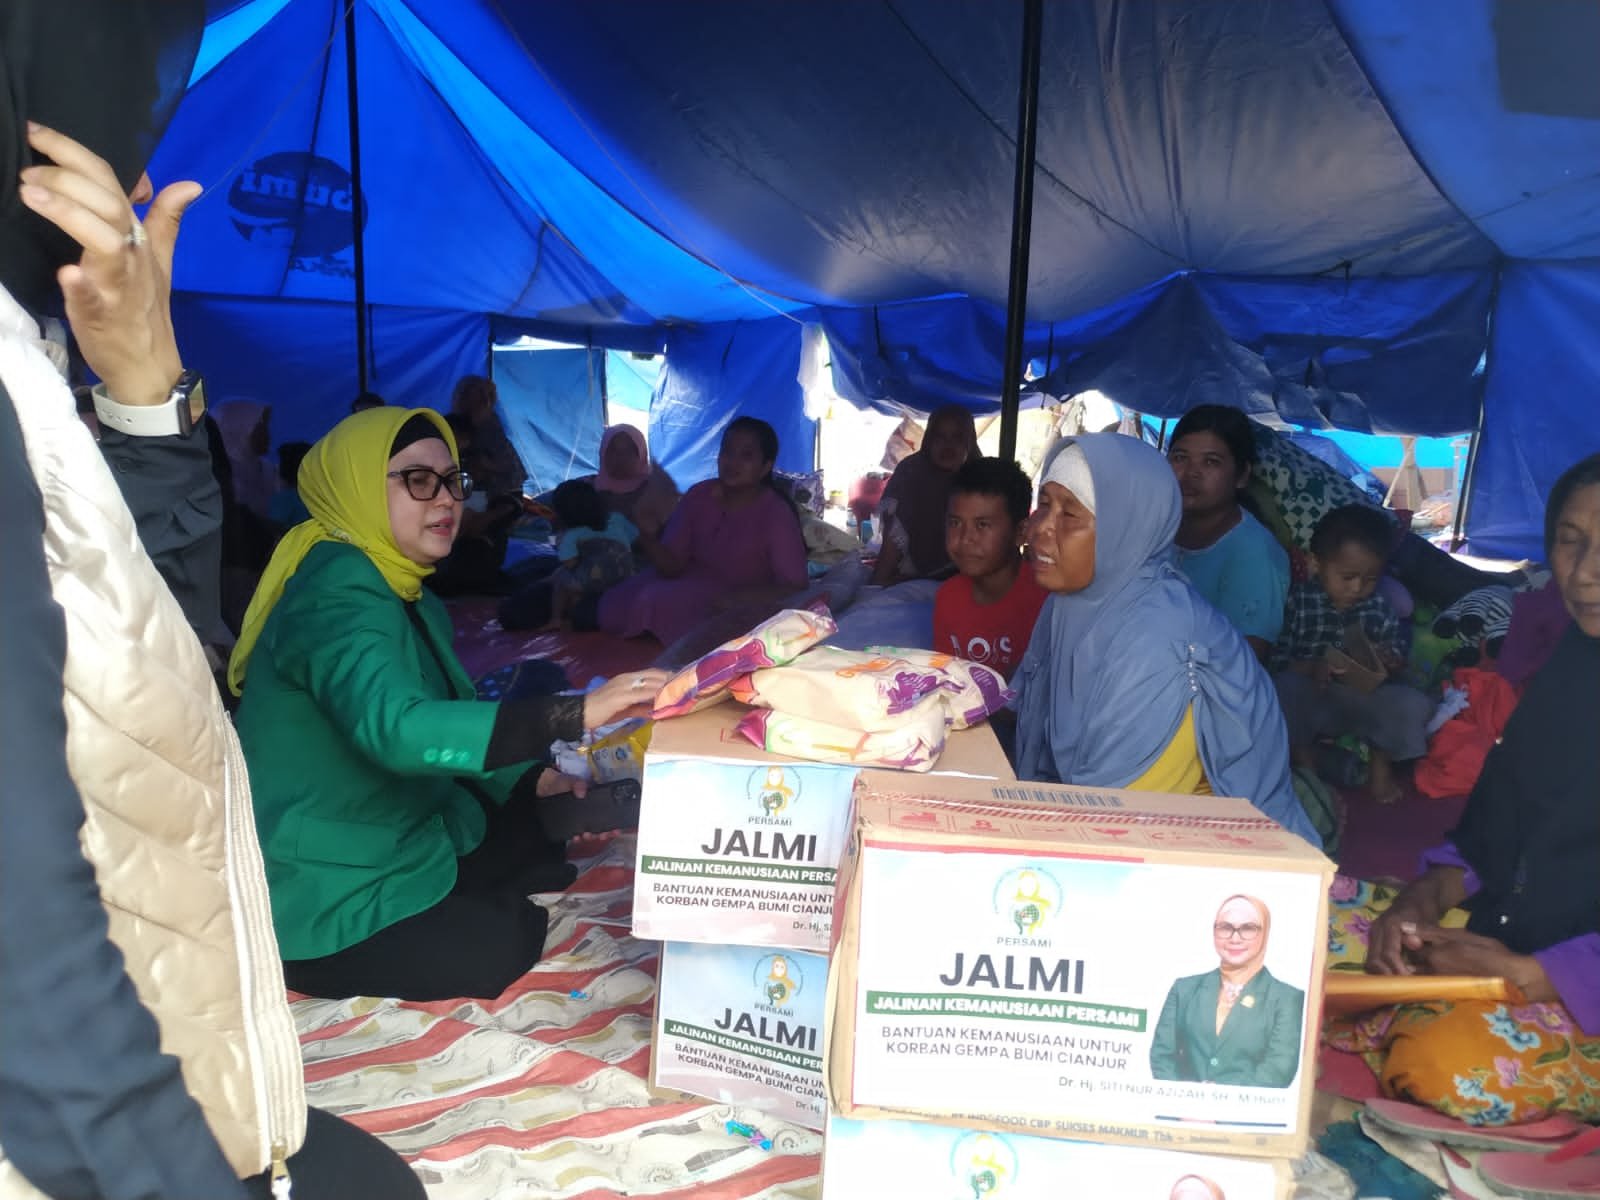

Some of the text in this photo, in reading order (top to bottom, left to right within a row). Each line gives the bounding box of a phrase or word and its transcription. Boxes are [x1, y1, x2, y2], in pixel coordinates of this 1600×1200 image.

[748, 816, 793, 827] PERSAMI
[701, 828, 817, 862] JALMI
[648, 860, 703, 874] JALINAN
[705, 864, 799, 881] KEMANUSIAAN
[653, 882, 714, 896] BANTUAN
[716, 886, 808, 902] KEMANUSIAAN
[656, 895, 709, 908] KORBAN
[711, 898, 755, 911] GEMPA
[758, 901, 790, 914] BUMI
[997, 936, 1053, 949] PERSAMI
[939, 953, 1085, 995] JALMI
[753, 1003, 794, 1018] PERSAMI
[874, 997, 1140, 1028] JALINAN KEMANUSIAAN PERSAMI
[669, 1023, 718, 1044] JALINAN
[717, 1035, 801, 1065] KEMANUSIAAN
[714, 1008, 817, 1051] JALMI
[882, 1026, 1133, 1055] BANTUAN KEMANUSIAAN UNTUK
[675, 1043, 727, 1064] BANTUAN
[728, 1057, 809, 1086] KEMANUSIAAN
[886, 1042, 1128, 1072] KORBAN GEMPA BUMI CIANJUR
[678, 1054, 723, 1073] KORBAN
[725, 1066, 763, 1084] GEMPA
[765, 1075, 793, 1092] BUMI
[1058, 1076, 1075, 1088] Dr.
[1080, 1079, 1096, 1092] Hj.
[1125, 1083, 1153, 1096] NUR
